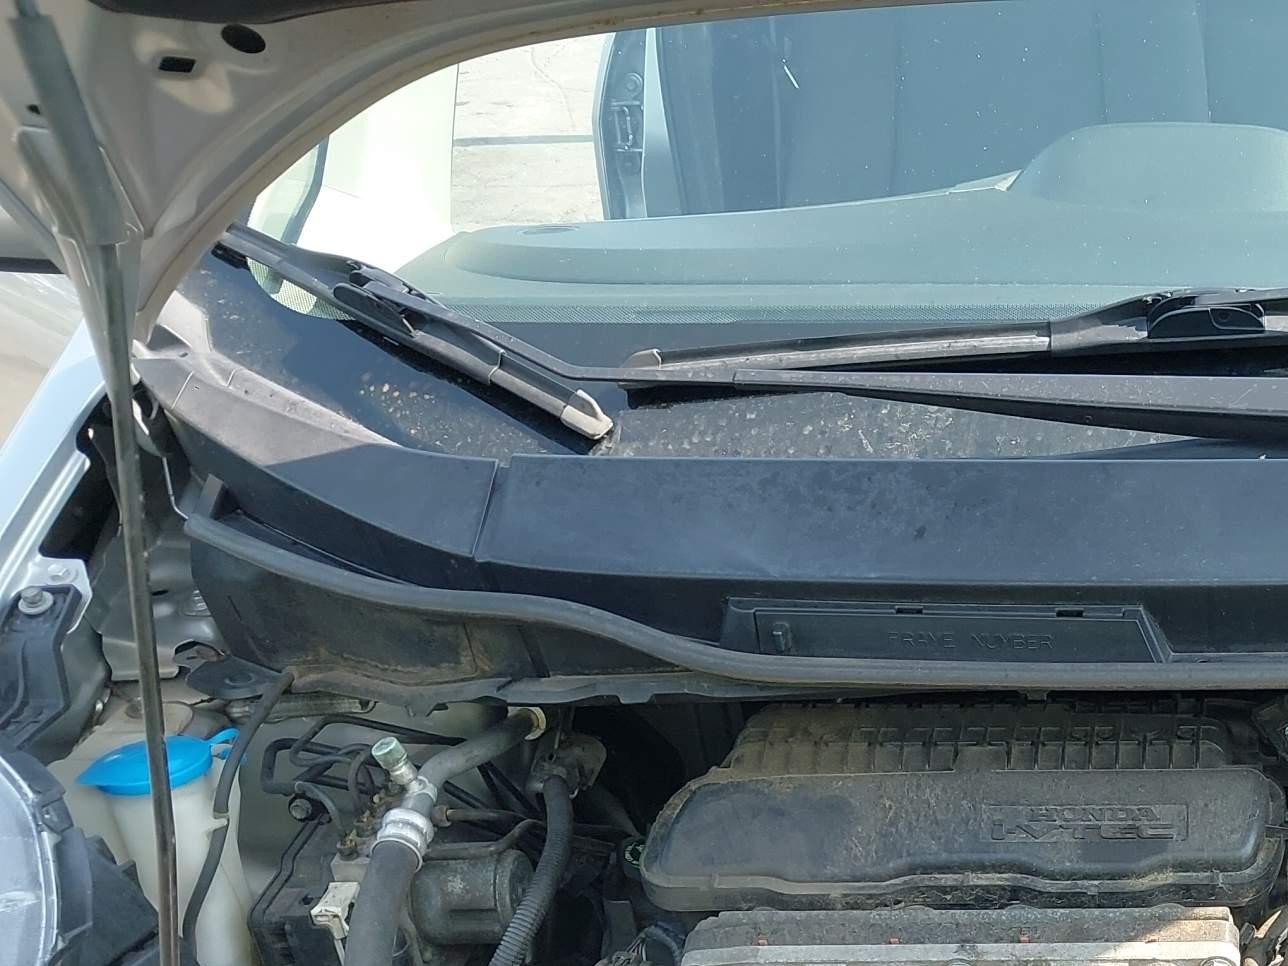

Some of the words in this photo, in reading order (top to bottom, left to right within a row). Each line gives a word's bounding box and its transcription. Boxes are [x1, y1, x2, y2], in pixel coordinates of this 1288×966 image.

[887, 631, 957, 649] FRAME
[970, 631, 1055, 649] NUMBER
[1028, 806, 1160, 822] HONDA
